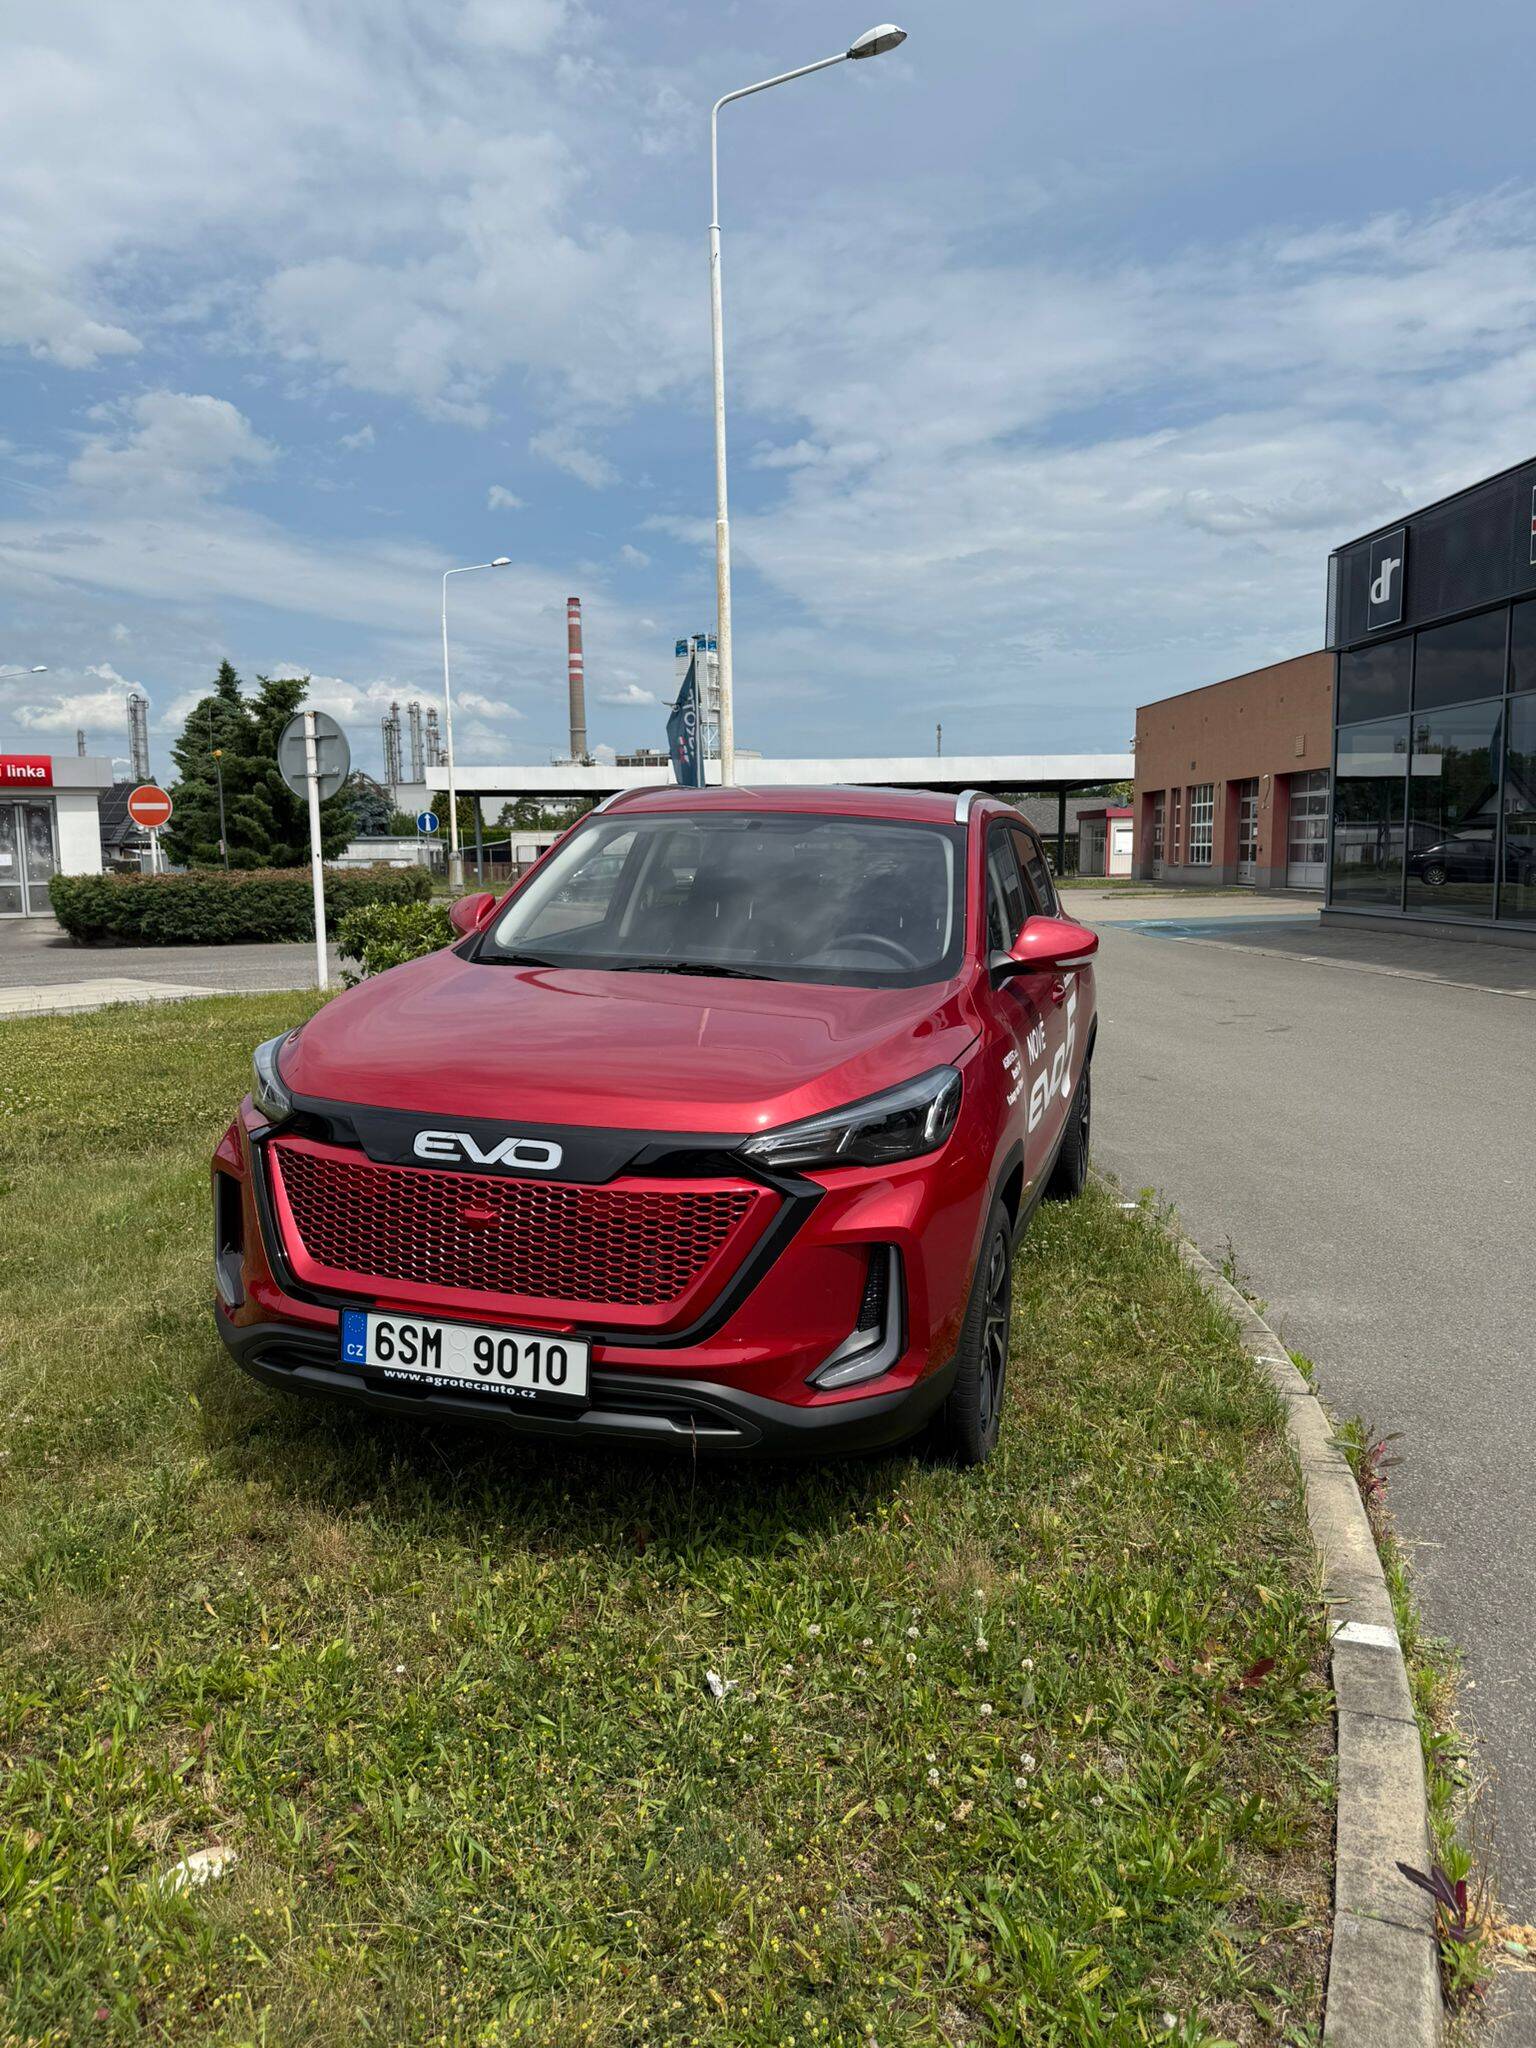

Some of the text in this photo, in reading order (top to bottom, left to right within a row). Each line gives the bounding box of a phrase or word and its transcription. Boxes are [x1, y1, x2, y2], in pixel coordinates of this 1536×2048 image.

[1370, 557, 1401, 605] dr
[6, 764, 46, 778] linka
[413, 1130, 563, 1171] EVO
[346, 1343, 364, 1357] CZ
[375, 1321, 568, 1386] 6SM 9010
[383, 1368, 537, 1399] www.agrotecauto.cz
